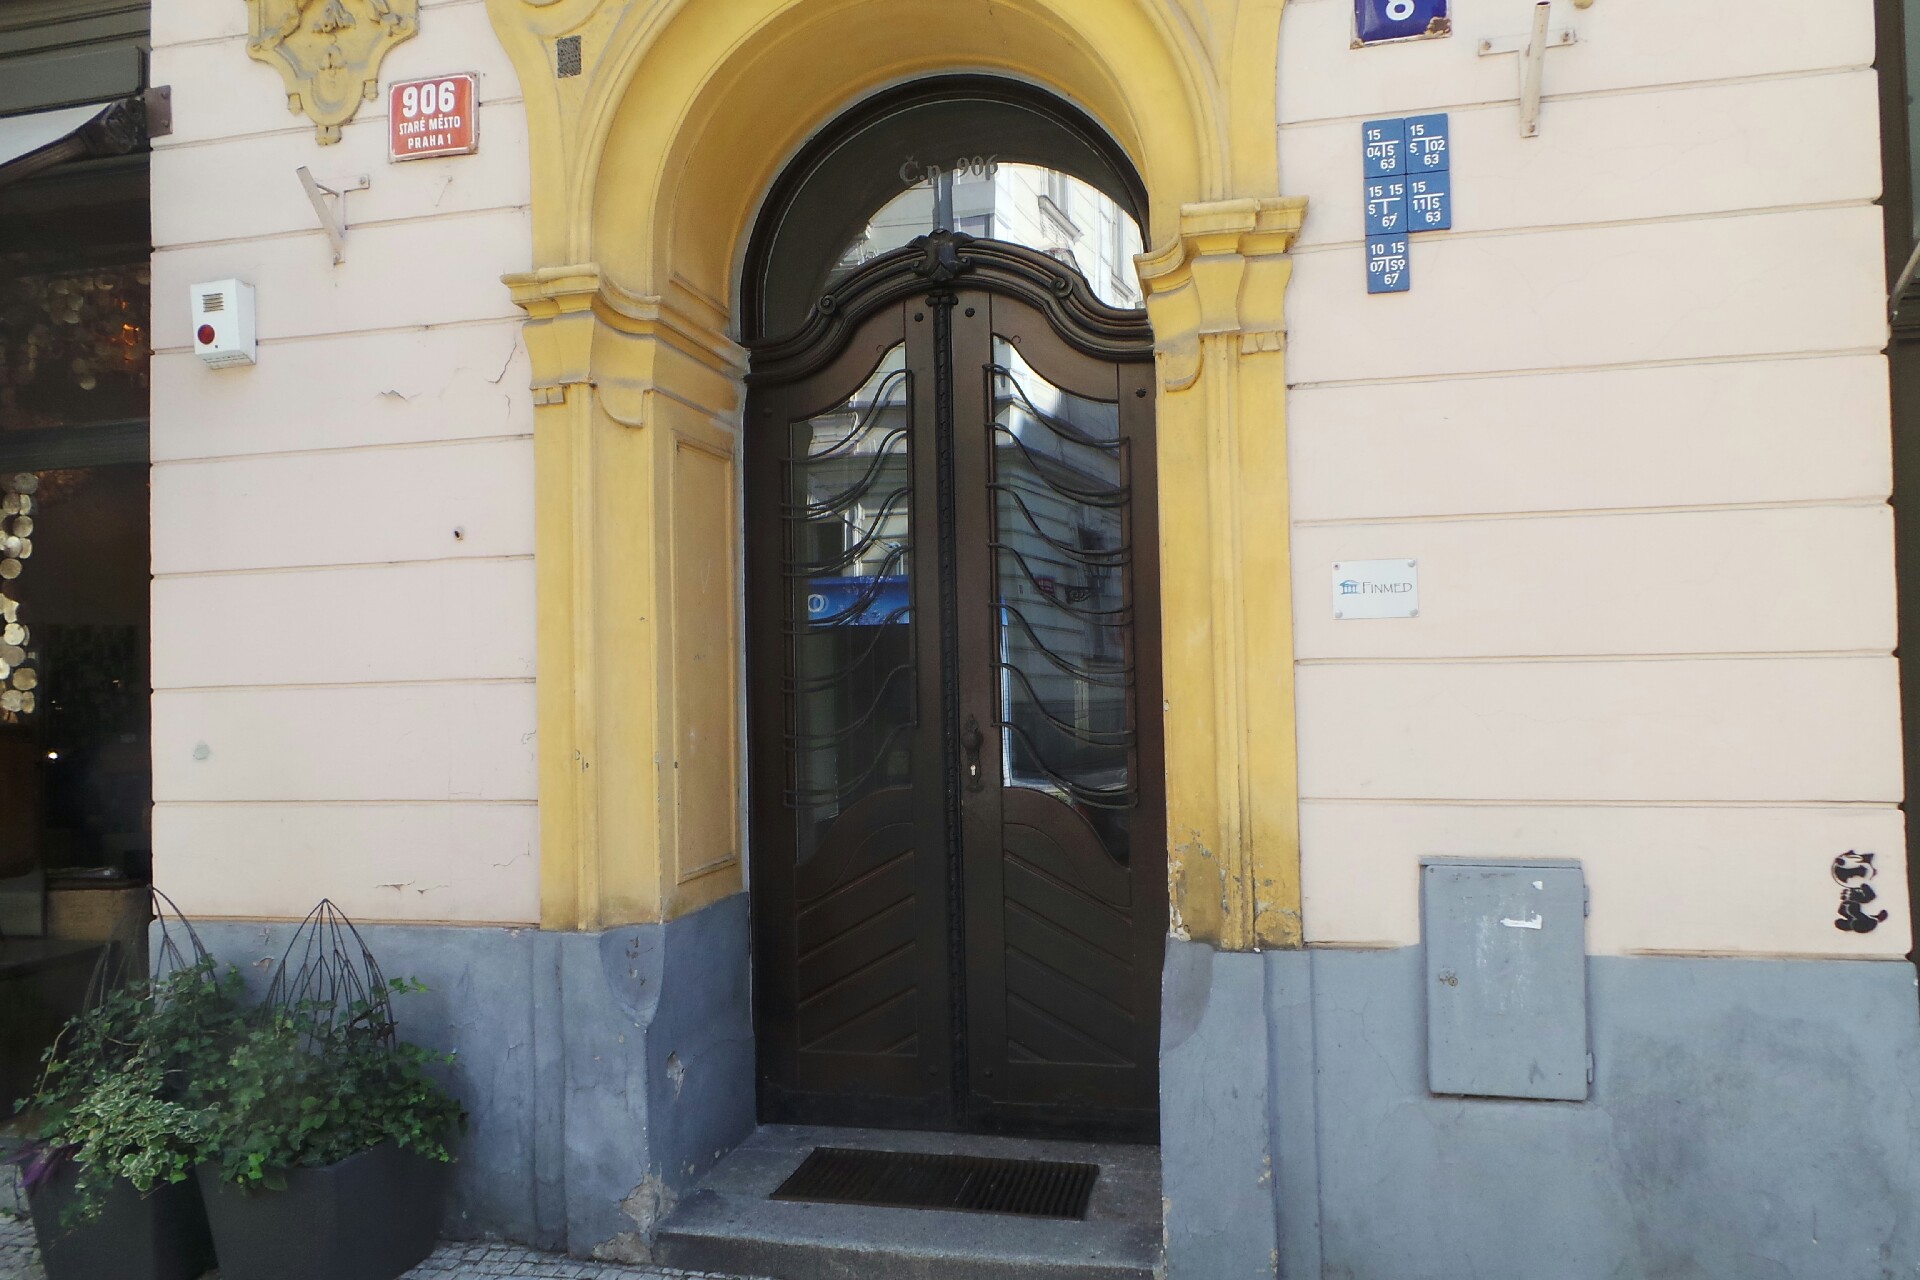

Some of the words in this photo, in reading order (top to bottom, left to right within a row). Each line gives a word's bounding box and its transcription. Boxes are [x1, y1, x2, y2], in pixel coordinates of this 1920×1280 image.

[402, 81, 455, 118] 906
[399, 117, 426, 135] STARÉ
[428, 114, 461, 131] MĚSTO
[1410, 124, 1424, 136] 15
[408, 134, 444, 149] PRAHA
[446, 133, 452, 144] 1
[1368, 129, 1381, 141] 15
[956, 153, 999, 181] 906
[1369, 185, 1383, 198] 15
[1389, 183, 1404, 196] 15
[1412, 181, 1426, 194] 15
[1370, 243, 1385, 255] 10
[1391, 241, 1405, 253] 15
